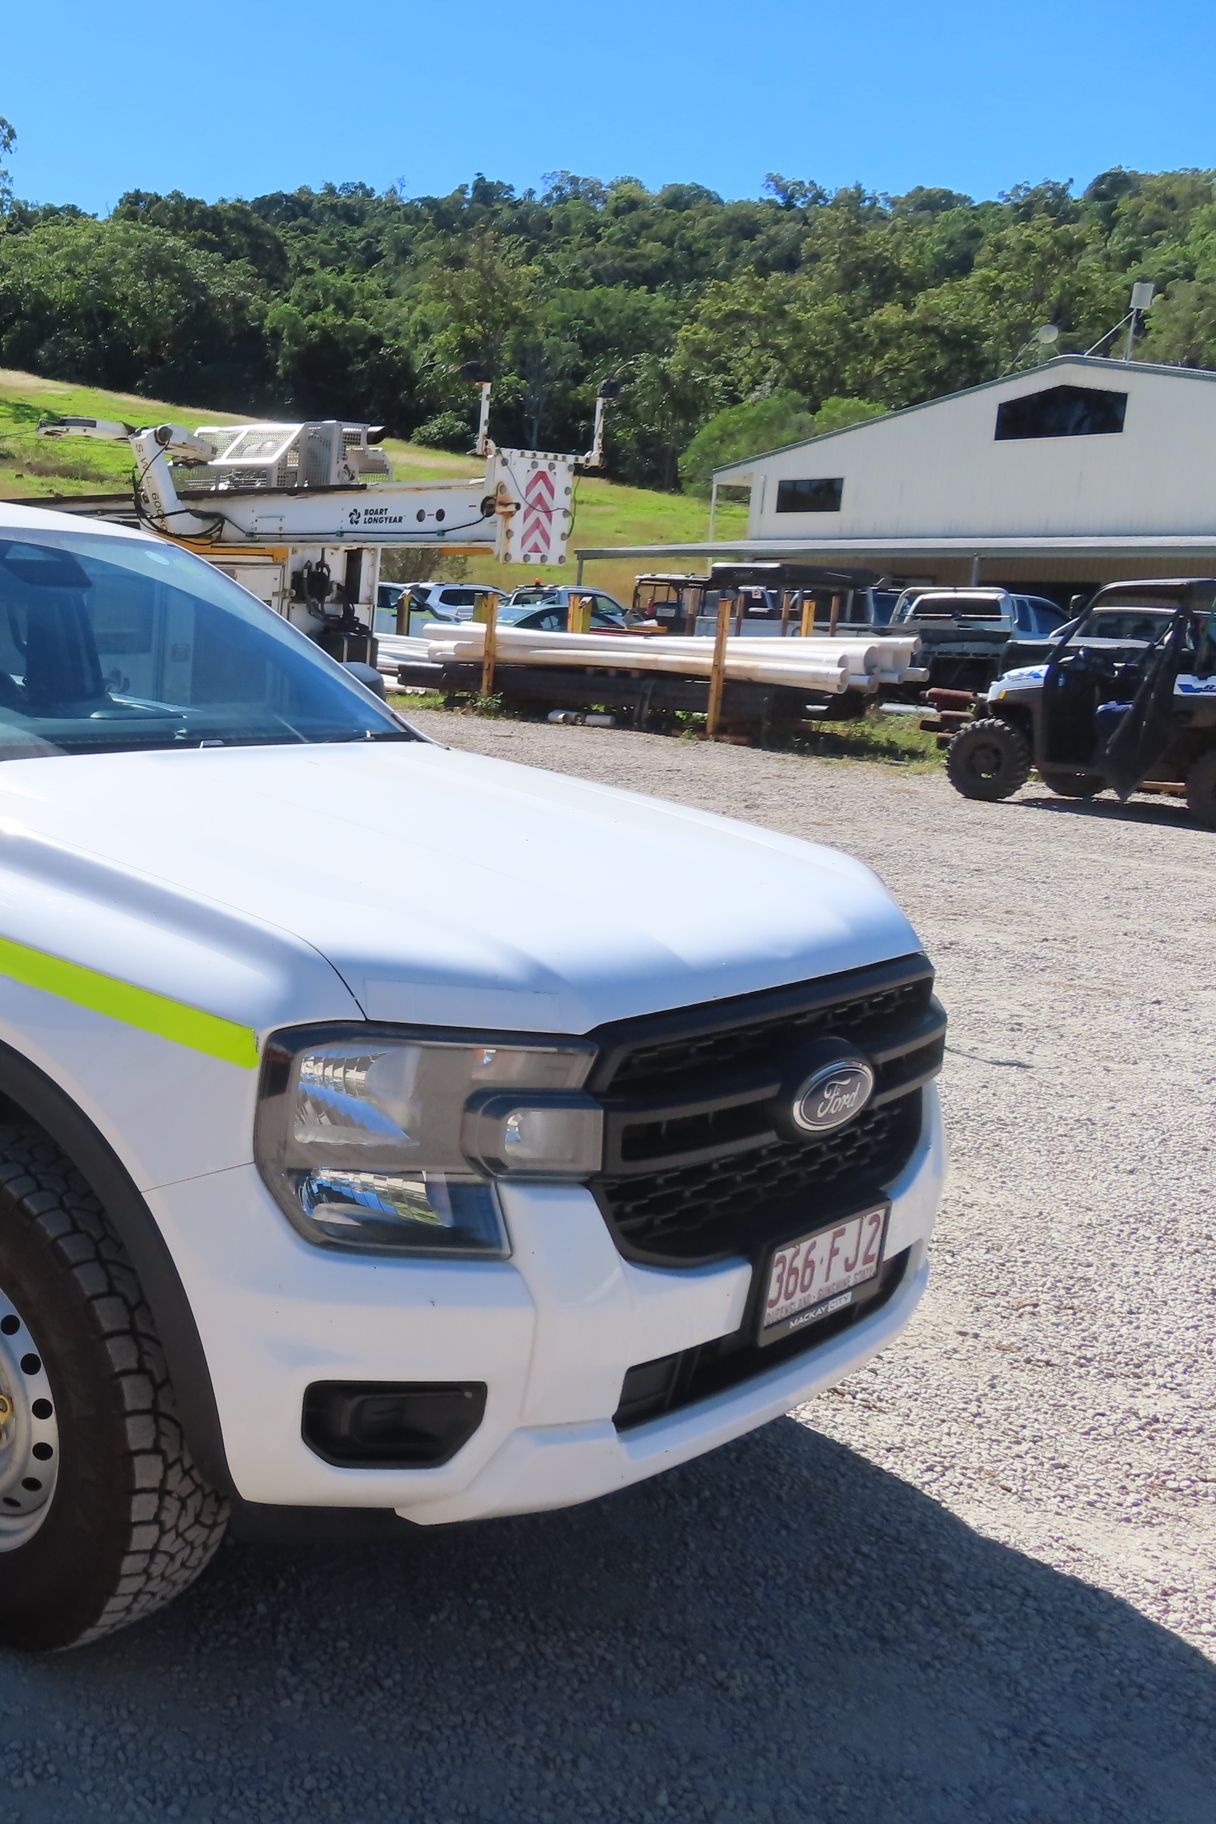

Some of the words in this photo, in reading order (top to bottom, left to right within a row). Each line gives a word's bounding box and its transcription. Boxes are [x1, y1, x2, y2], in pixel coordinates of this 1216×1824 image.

[364, 508, 388, 516] BOART
[364, 516, 403, 525] LONGYEAR
[817, 1078, 861, 1118] Ford
[789, 1305, 829, 1328] MACKAY
